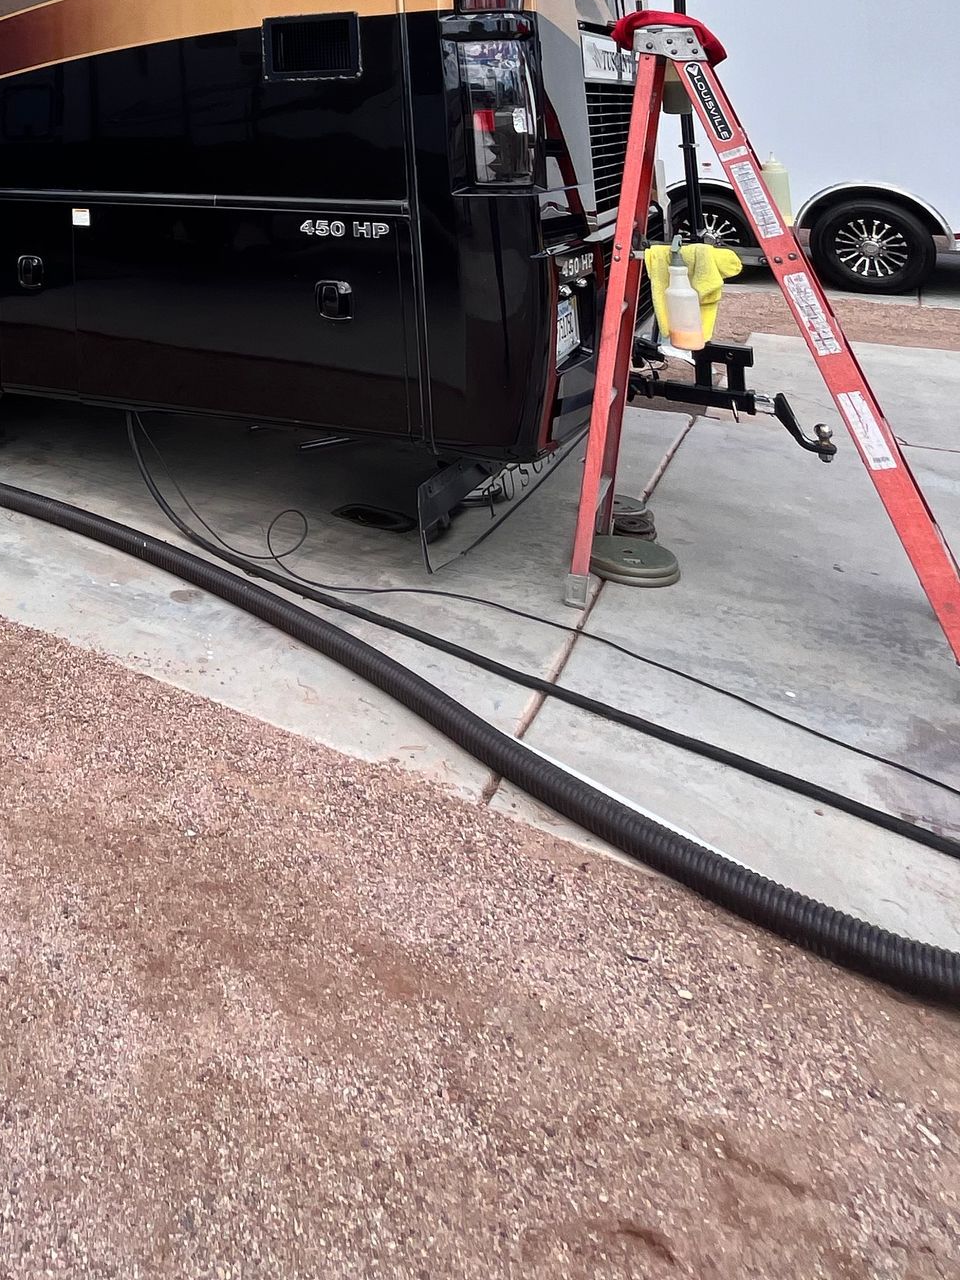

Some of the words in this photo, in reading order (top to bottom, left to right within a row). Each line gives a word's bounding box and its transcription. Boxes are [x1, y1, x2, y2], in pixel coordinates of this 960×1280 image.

[693, 75, 730, 140] LOUISVILLE
[300, 220, 345, 237] 450
[353, 221, 390, 239] HP
[561, 257, 579, 277] 450
[581, 252, 594, 271] HP
